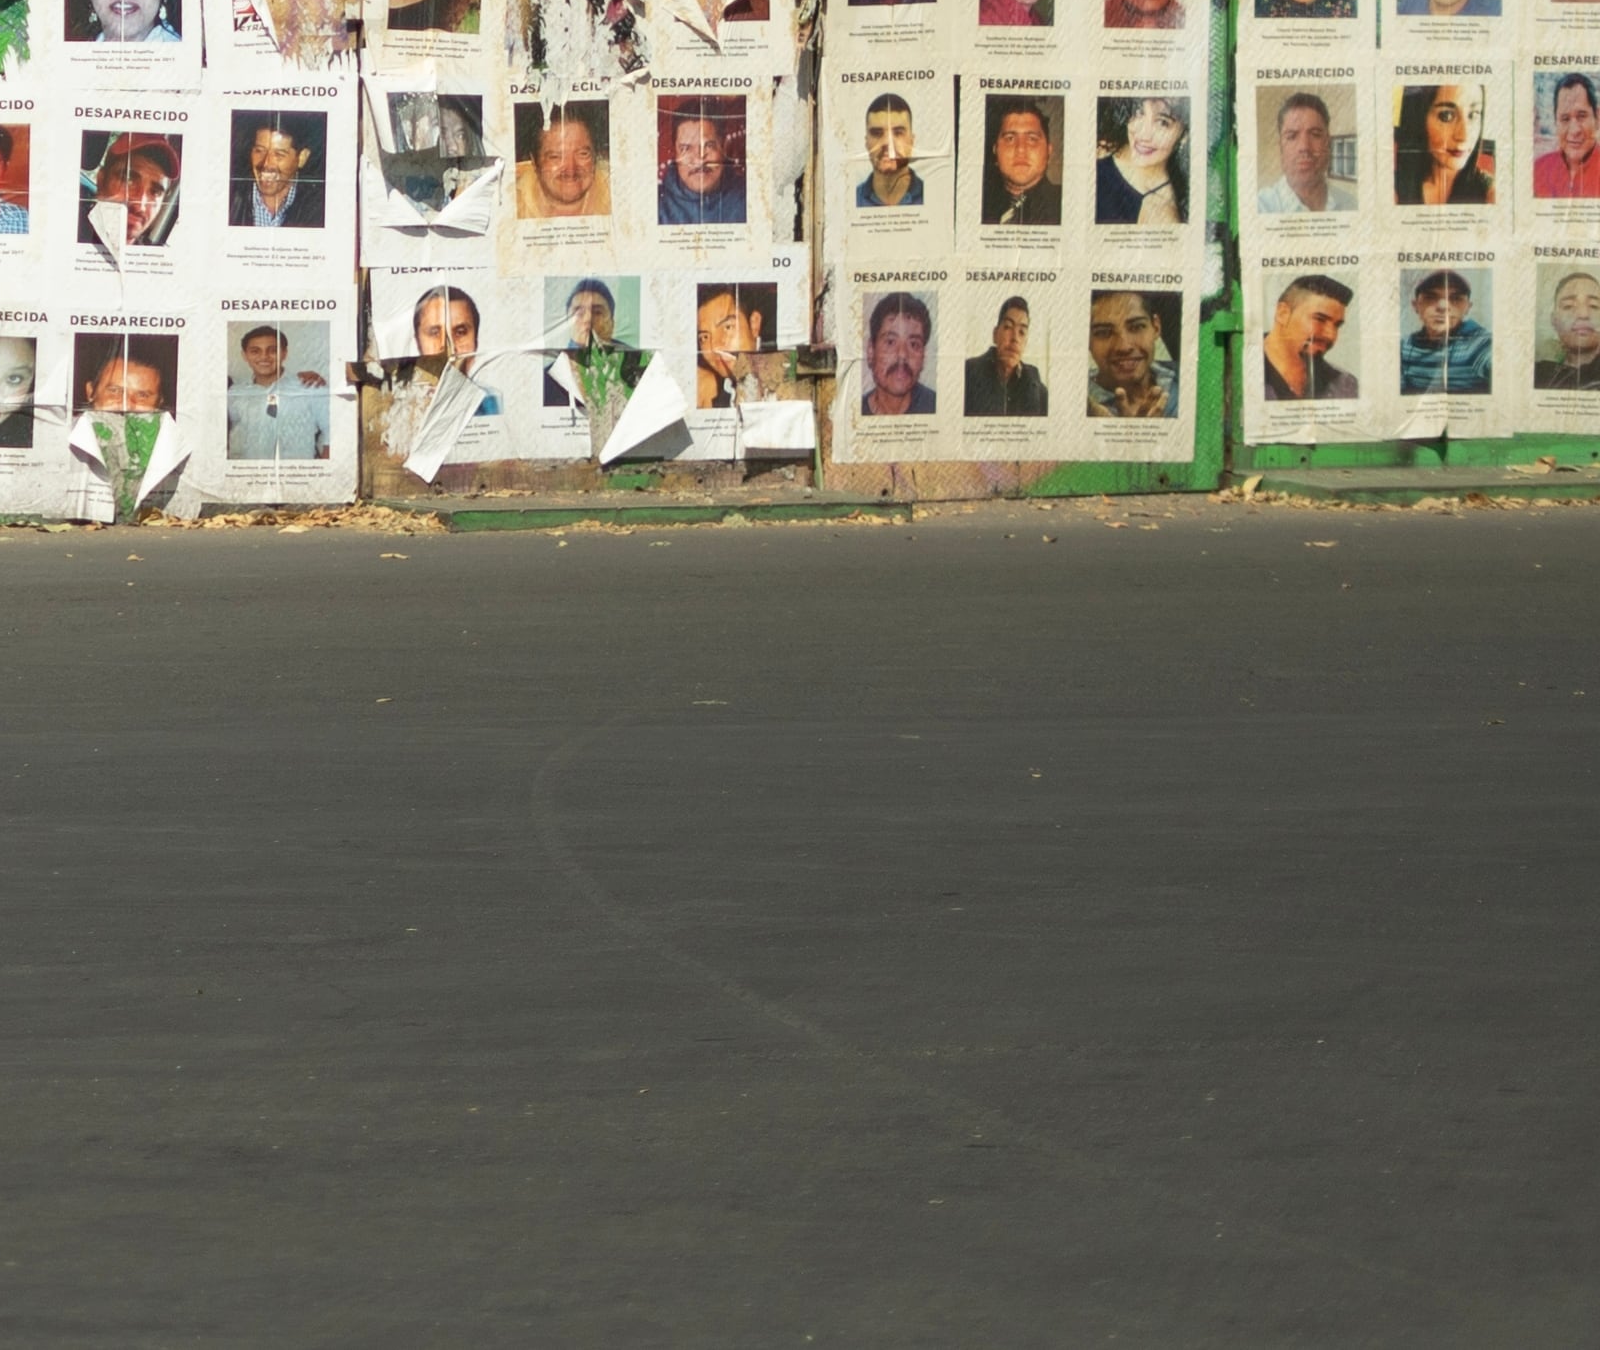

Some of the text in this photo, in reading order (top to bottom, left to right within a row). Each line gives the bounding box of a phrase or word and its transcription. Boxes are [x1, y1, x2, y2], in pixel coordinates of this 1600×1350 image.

[841, 69, 936, 84] DESAPARECIDO
[1256, 67, 1355, 80] DESAPARECIDO
[1395, 64, 1493, 76] DESAPARECIDA
[651, 76, 753, 89] DESAPARECIDO
[979, 78, 1071, 90] DESAPARECIDO
[1099, 79, 1190, 91] DESAPARECIDA
[74, 106, 189, 122] DESAPARECIDO
[1261, 254, 1360, 268] DESAPARECIDO
[1397, 251, 1495, 263] DESAPARECIDO
[853, 270, 948, 283] DESAPARECIDO
[965, 270, 1057, 283] DESAPARECIDO
[1091, 272, 1183, 285] DESAPARECIDO
[221, 299, 337, 311] DESAPARECIDO
[70, 315, 186, 328] DESAPARECIDO
